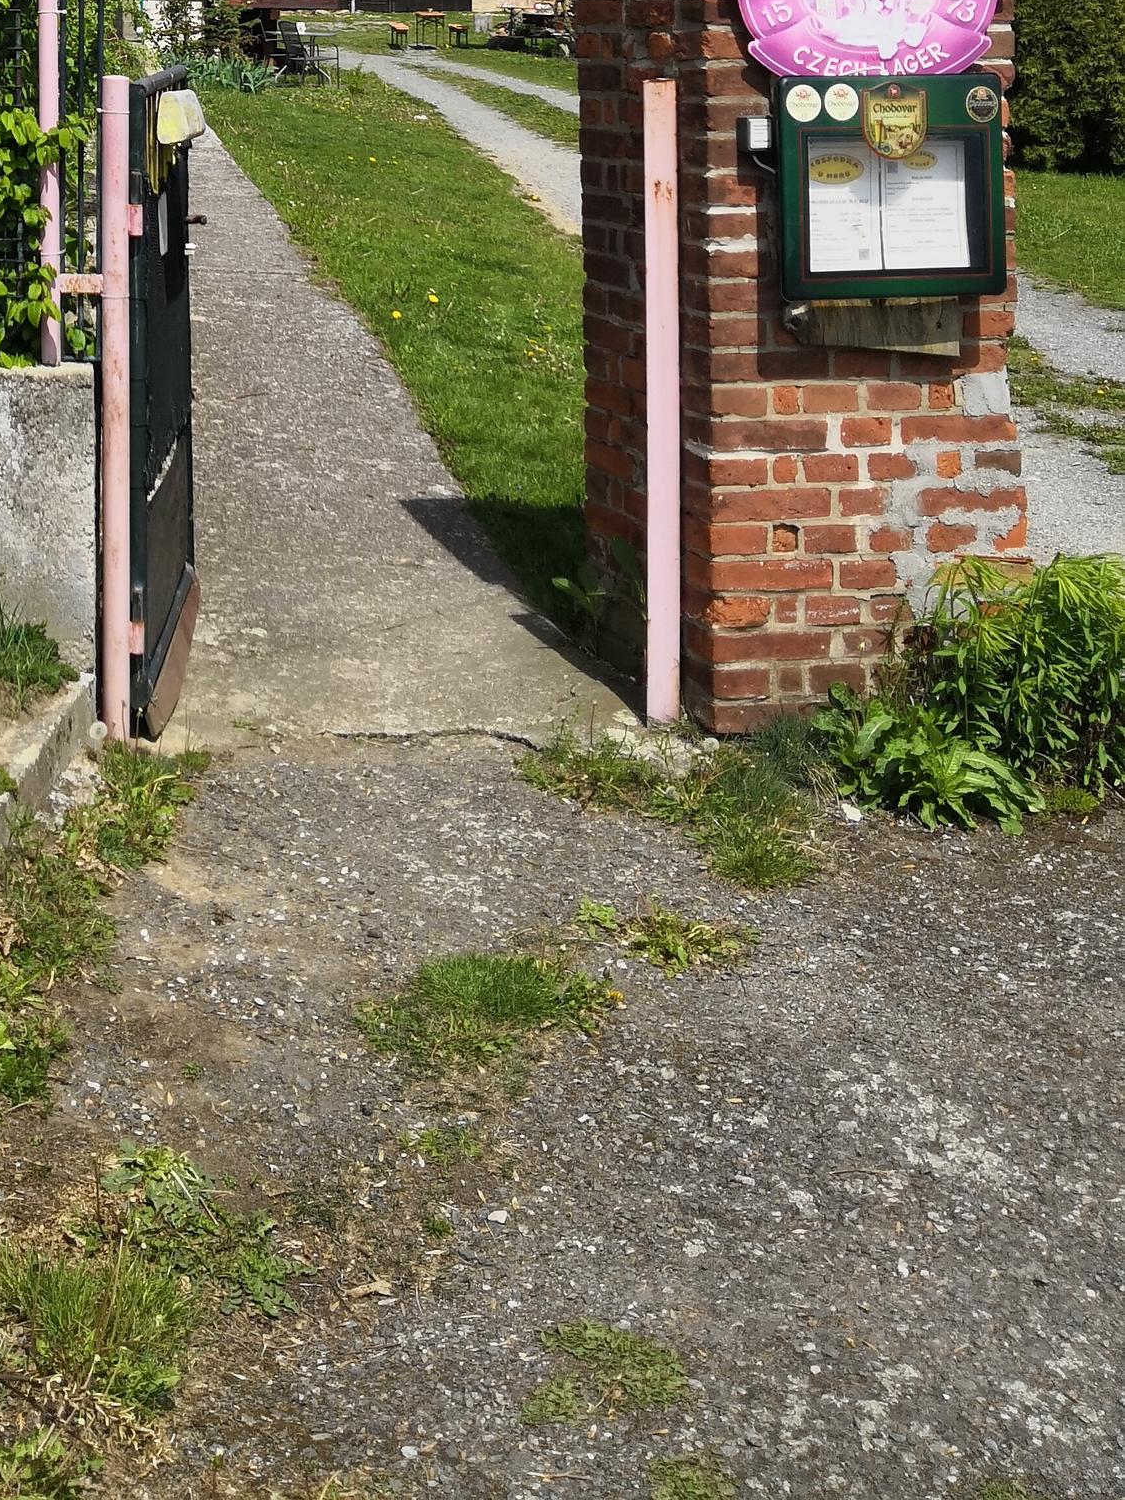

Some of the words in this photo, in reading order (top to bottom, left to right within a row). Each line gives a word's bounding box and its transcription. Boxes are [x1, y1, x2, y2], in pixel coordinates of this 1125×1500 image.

[761, 0, 793, 28] 15
[793, 45, 867, 77] CZECH
[878, 41, 952, 77] LAGER
[873, 102, 918, 114] Chodovar
